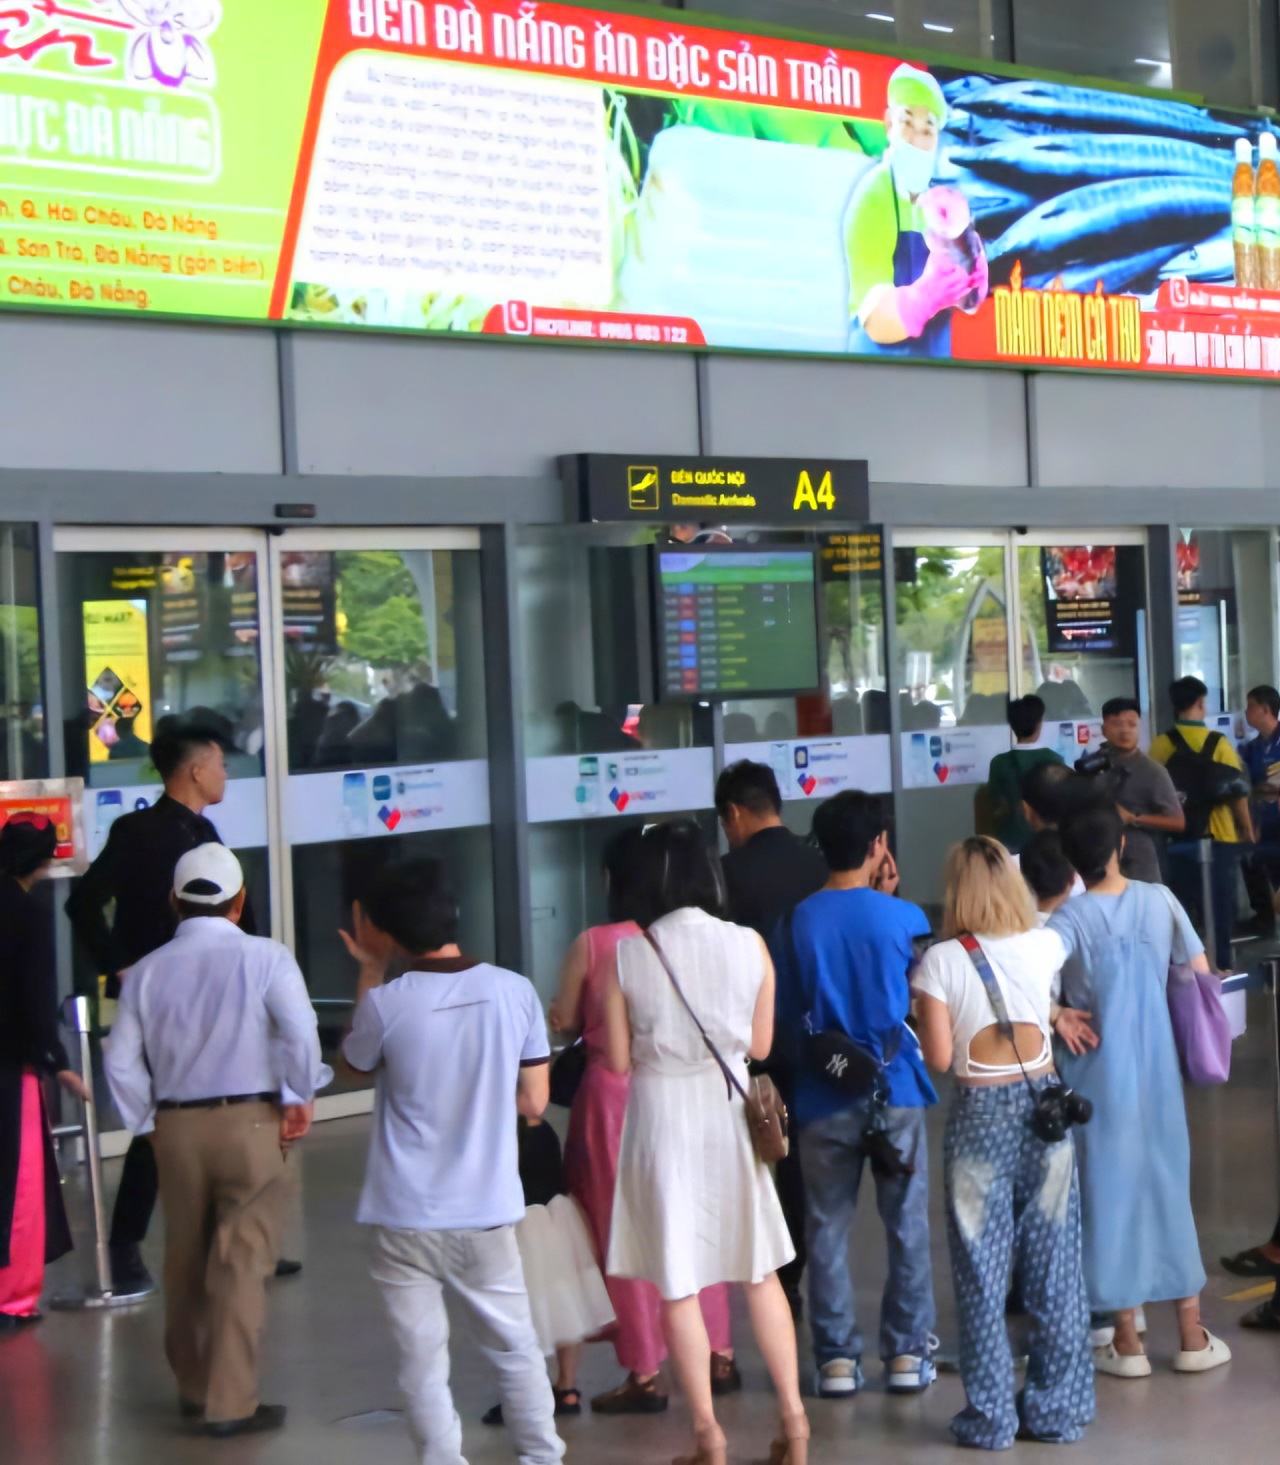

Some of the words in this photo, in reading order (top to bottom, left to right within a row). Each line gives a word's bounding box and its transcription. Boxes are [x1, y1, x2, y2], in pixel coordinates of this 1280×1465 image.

[435, 0, 483, 54] ĐÀ
[493, 1, 585, 68] NẴNG
[594, 21, 638, 77] ĂN
[646, 32, 711, 89] ĐẶC
[717, 40, 778, 97] SẢN
[784, 49, 861, 108] TRẦN
[793, 469, 836, 511] A4
